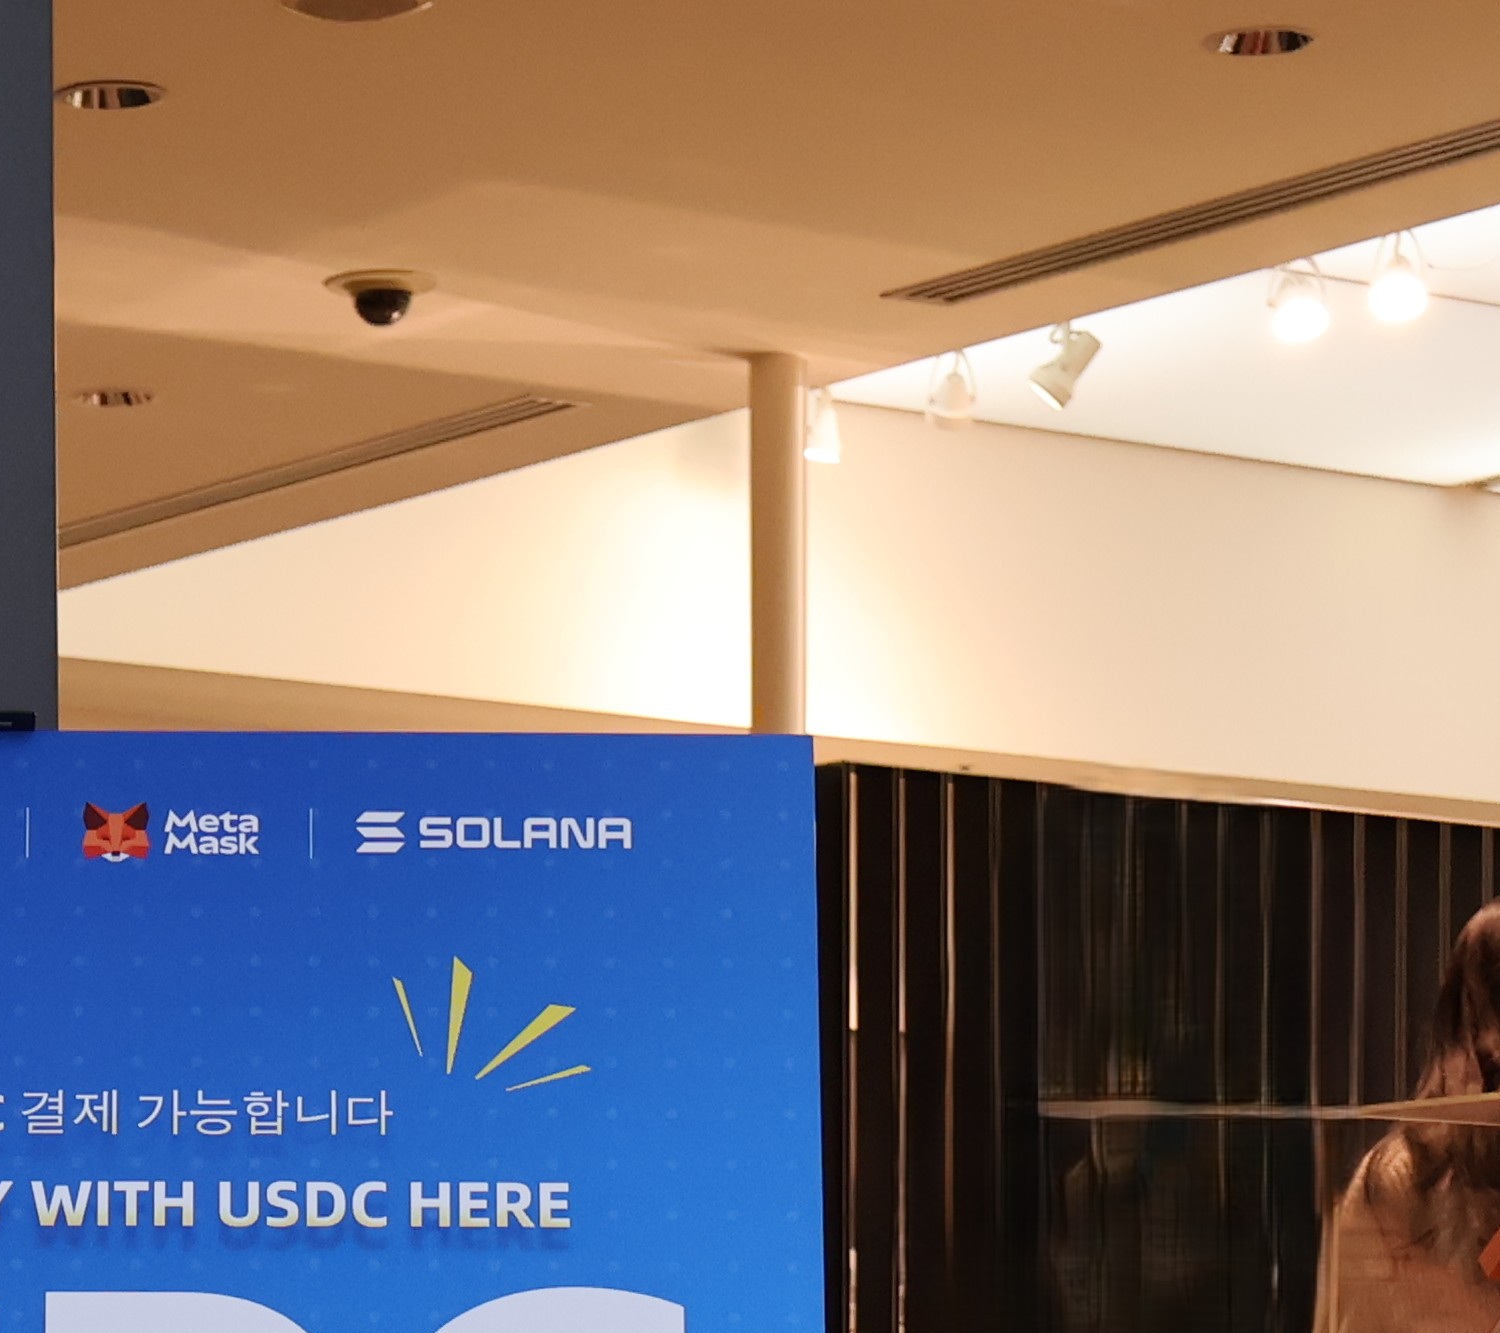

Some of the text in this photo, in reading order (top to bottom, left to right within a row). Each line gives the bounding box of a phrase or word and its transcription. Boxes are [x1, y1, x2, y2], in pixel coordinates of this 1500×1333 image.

[164, 809, 259, 833] Meta
[419, 816, 632, 850] SOLANA
[164, 831, 259, 855] Mask
[21, 1089, 119, 1135] 결제
[137, 1089, 394, 1136] 가능합니다
[30, 1180, 194, 1228] WITH
[219, 1180, 388, 1229] USDC
[410, 1180, 571, 1229] HERE
